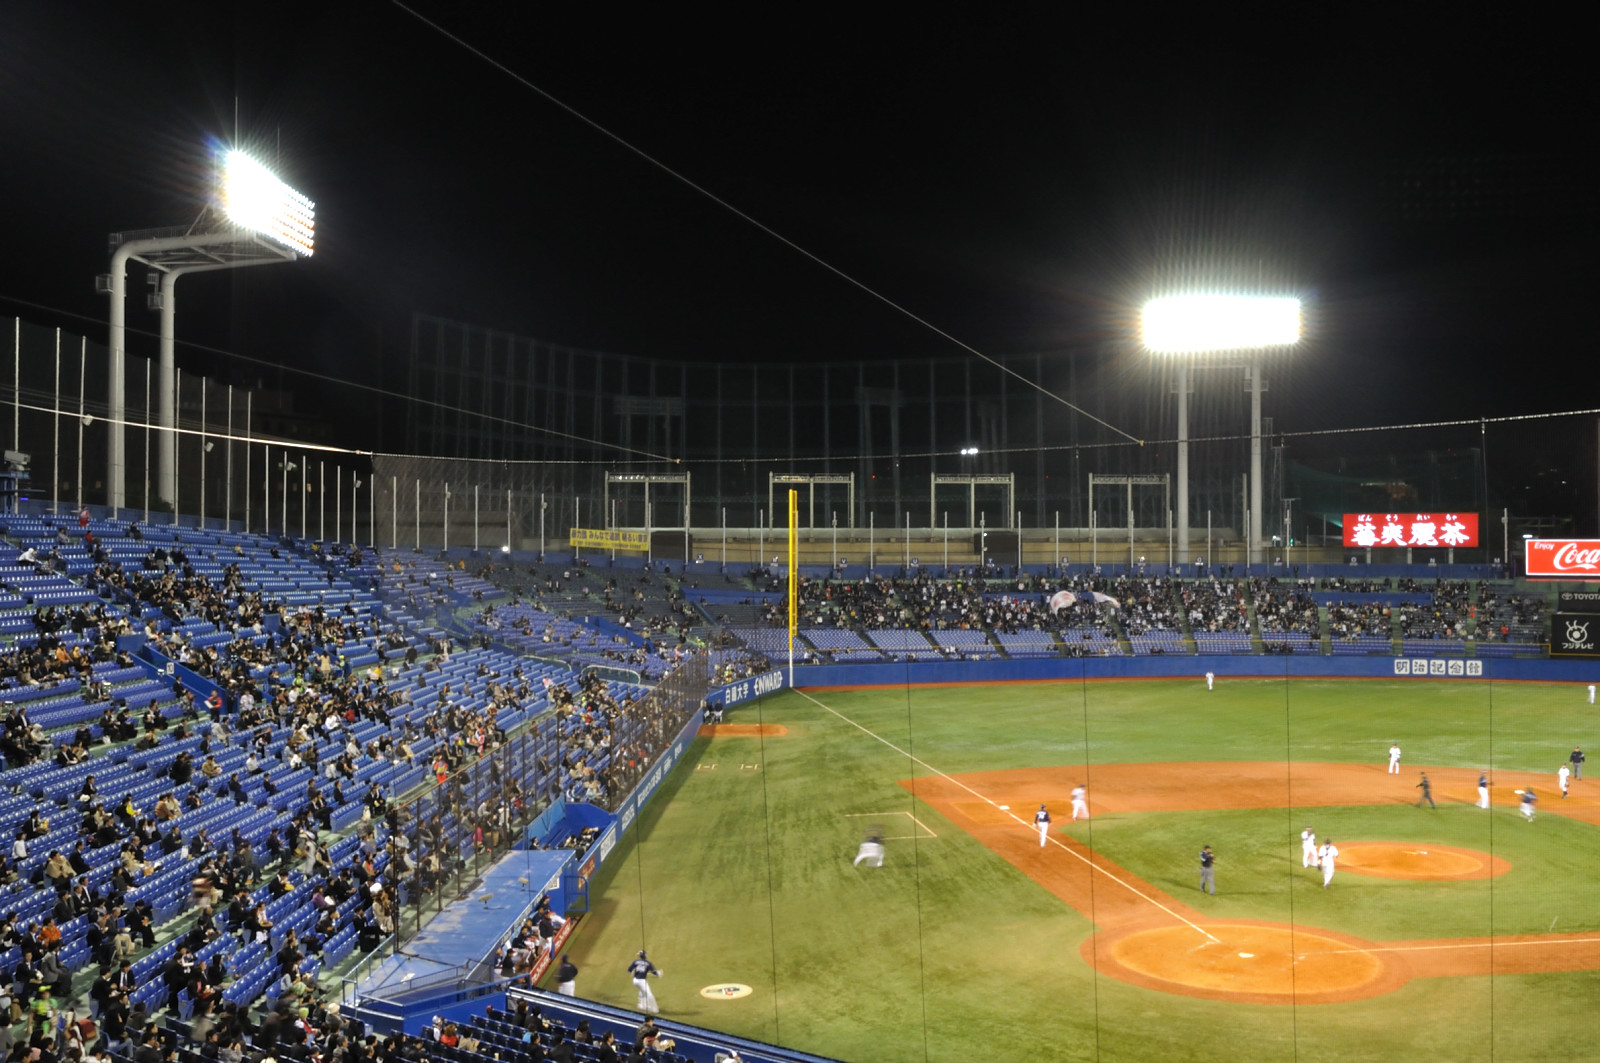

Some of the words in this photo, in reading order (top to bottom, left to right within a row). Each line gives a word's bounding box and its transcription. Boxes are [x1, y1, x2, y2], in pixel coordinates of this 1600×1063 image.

[1534, 542, 1555, 550] Enjoy
[1396, 661, 1480, 674] 明治記念館
